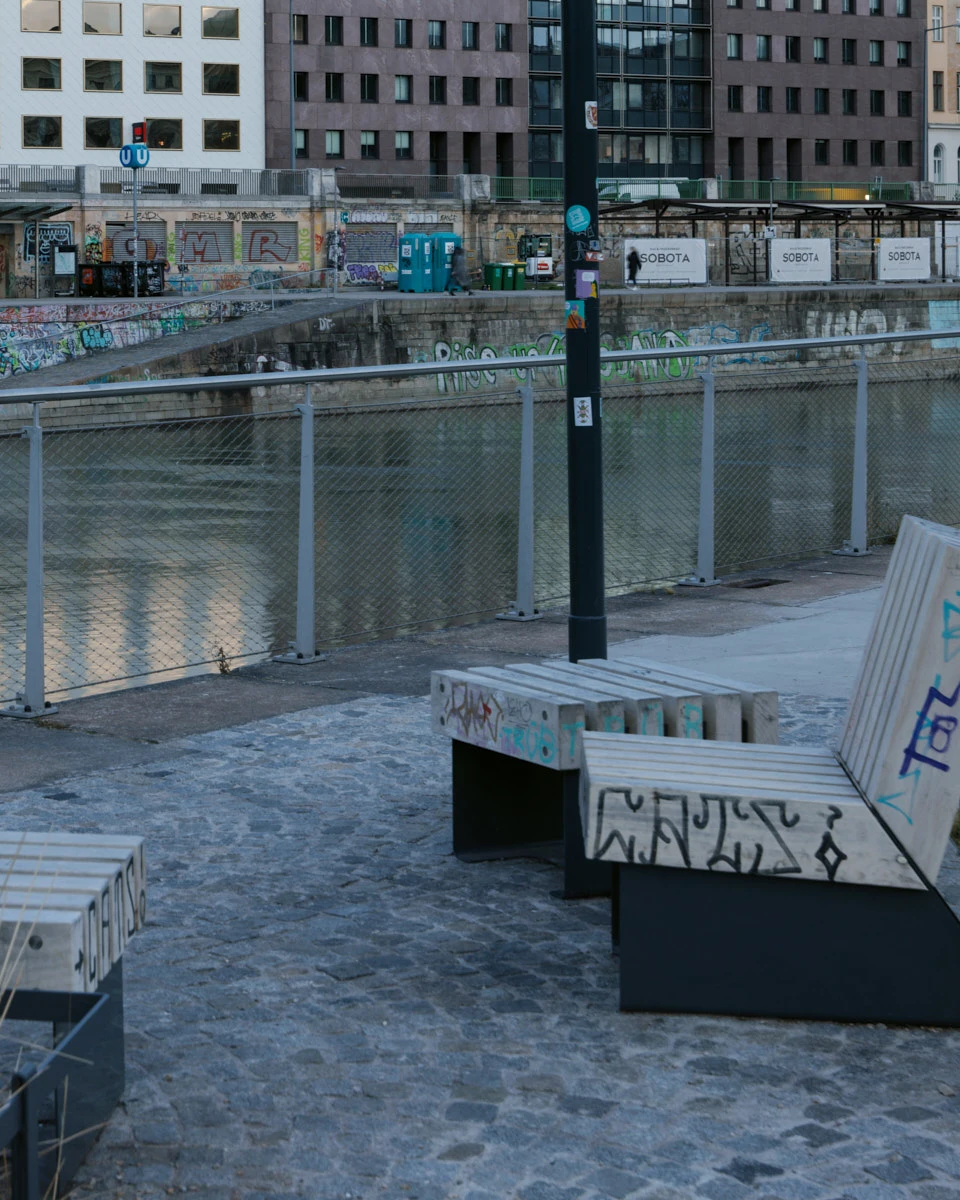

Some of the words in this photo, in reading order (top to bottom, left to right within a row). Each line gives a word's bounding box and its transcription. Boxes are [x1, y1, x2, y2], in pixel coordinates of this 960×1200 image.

[121, 149, 132, 165] U
[136, 148, 148, 165] U
[640, 253, 690, 263] SOBOTA
[782, 252, 819, 263] SOBOTA
[888, 251, 921, 261] SOBOTA
